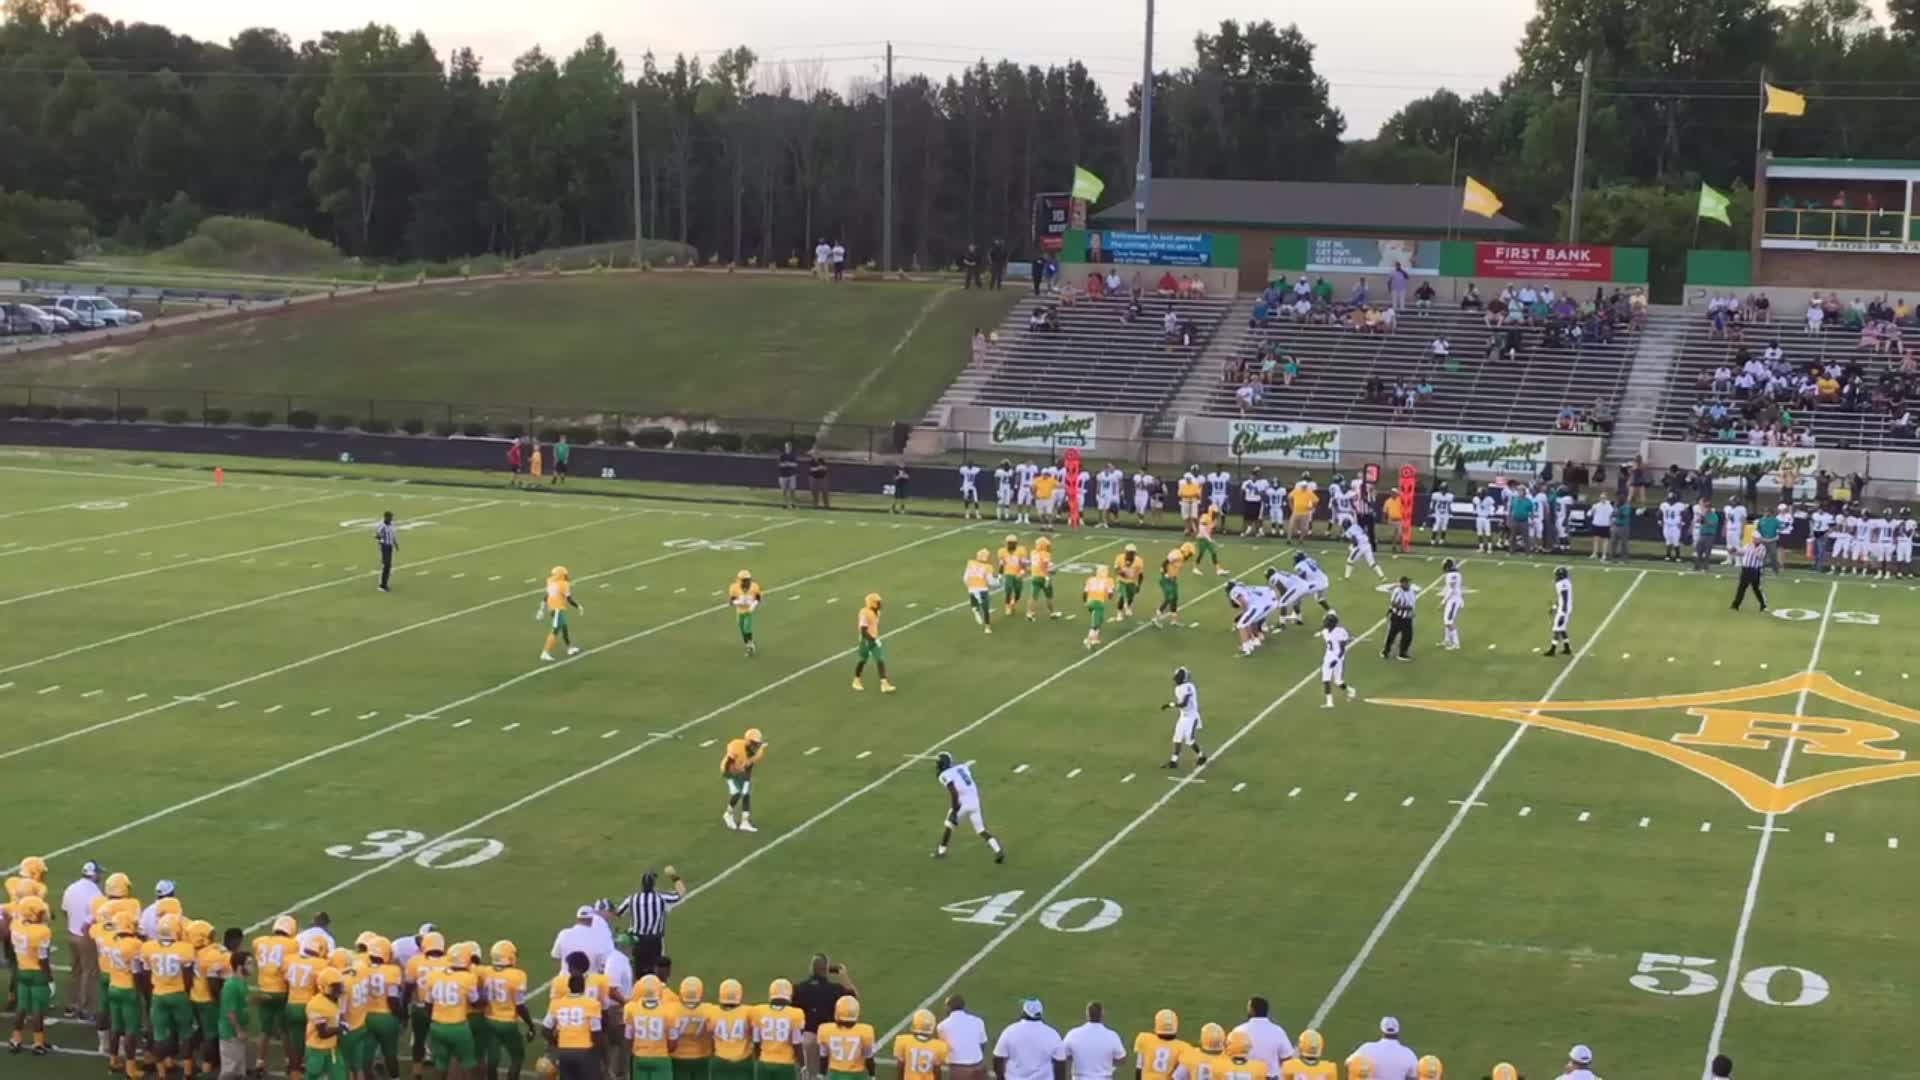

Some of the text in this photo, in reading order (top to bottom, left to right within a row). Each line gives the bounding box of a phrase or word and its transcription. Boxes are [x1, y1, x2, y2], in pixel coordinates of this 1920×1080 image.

[1495, 247, 1591, 262] FIRST BANK
[992, 415, 1094, 443] Champions
[1231, 428, 1338, 456] Champions
[1671, 707, 1906, 761] R
[325, 829, 504, 870] 30
[940, 890, 1123, 932] 40
[149, 952, 181, 977] 36
[257, 943, 284, 967] 34
[286, 963, 313, 988] 47
[1629, 952, 1830, 1007] 50
[431, 979, 459, 1006] 46
[633, 1015, 664, 1041] 59
[714, 1018, 746, 1041] 44
[759, 1016, 791, 1041] 28
[830, 1035, 861, 1062] 57
[1153, 1047, 1170, 1073] 8
